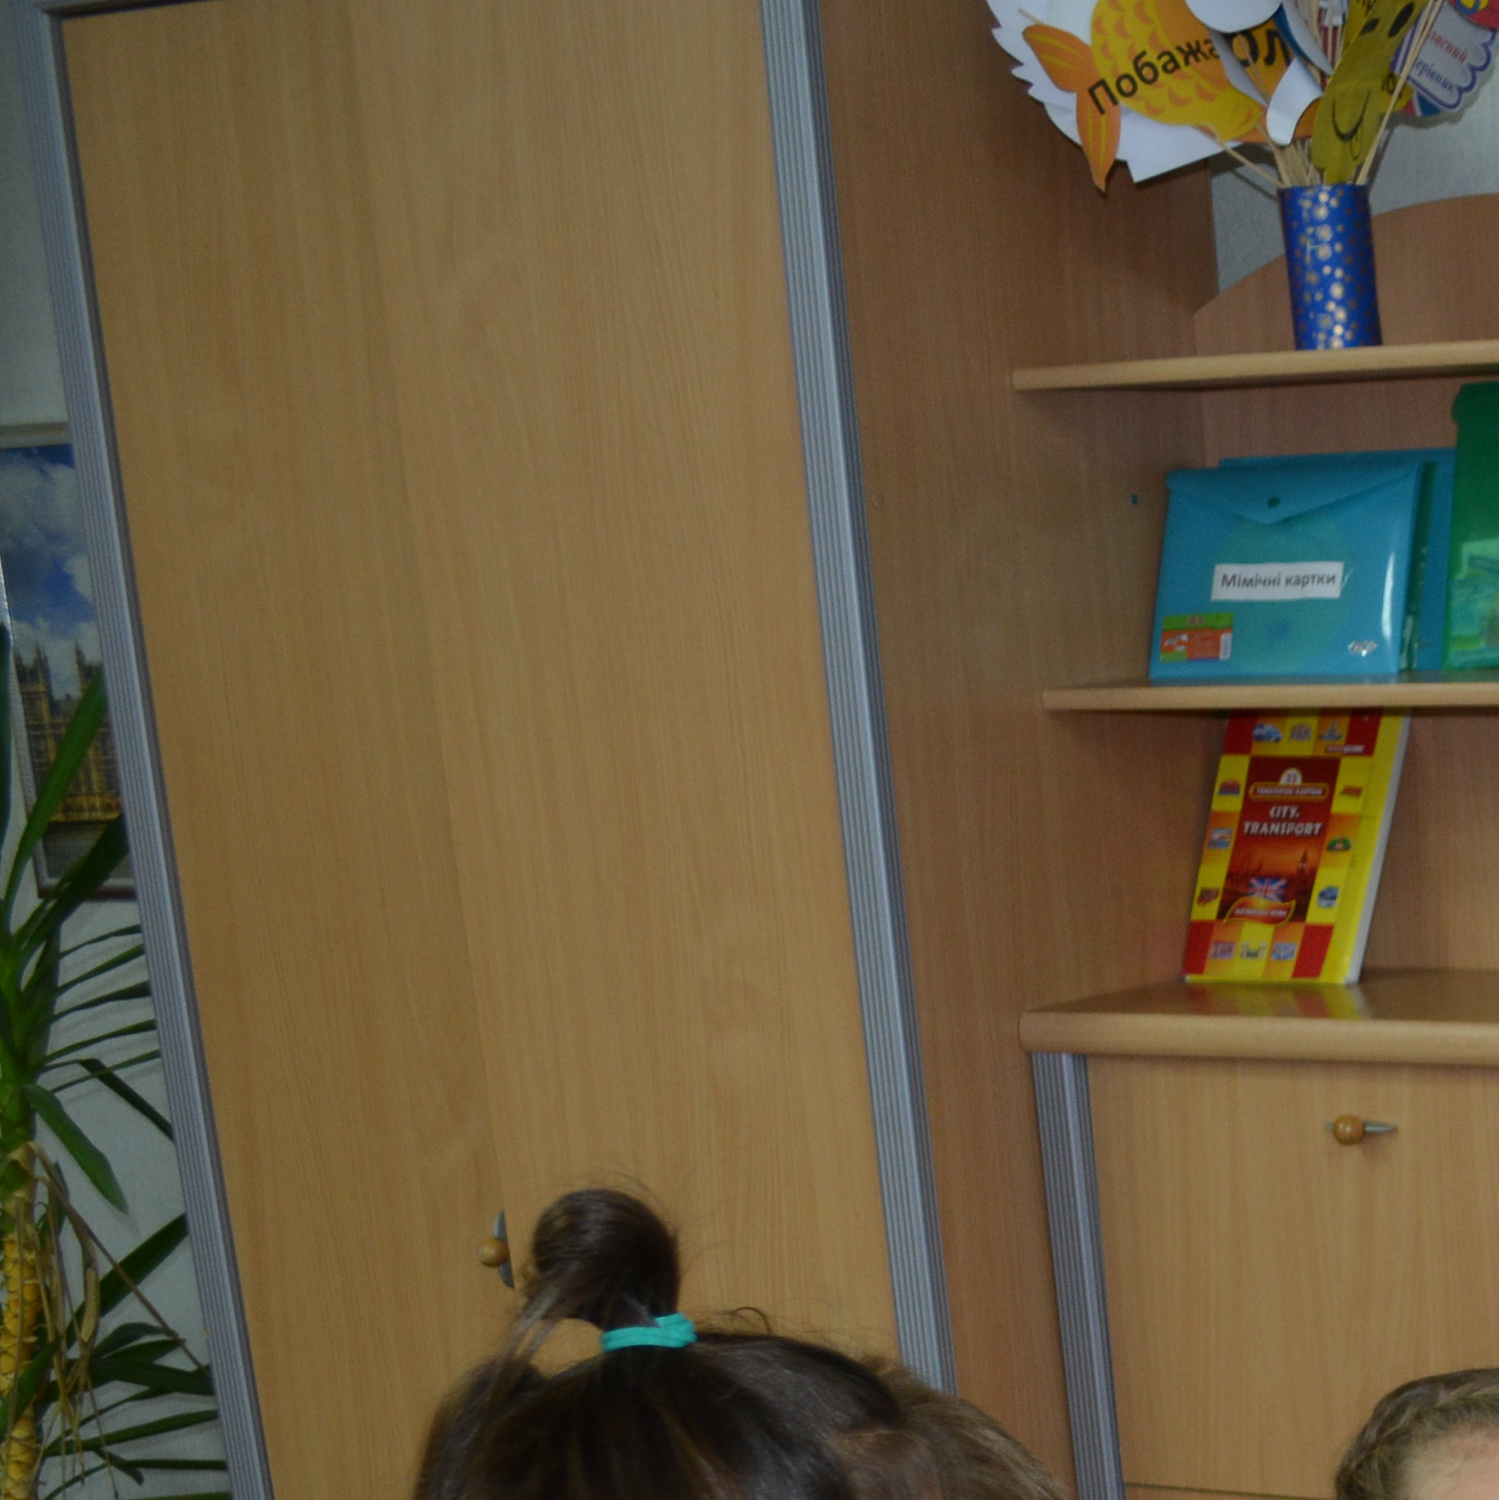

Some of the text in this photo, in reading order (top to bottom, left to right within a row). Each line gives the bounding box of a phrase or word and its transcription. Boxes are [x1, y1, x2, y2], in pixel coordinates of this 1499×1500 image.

[1428, 30, 1467, 63] ласний
[1413, 57, 1458, 92] ерівник
[1221, 571, 1337, 588] Мімічні картки
[1243, 821, 1323, 836] TRANSPORT
